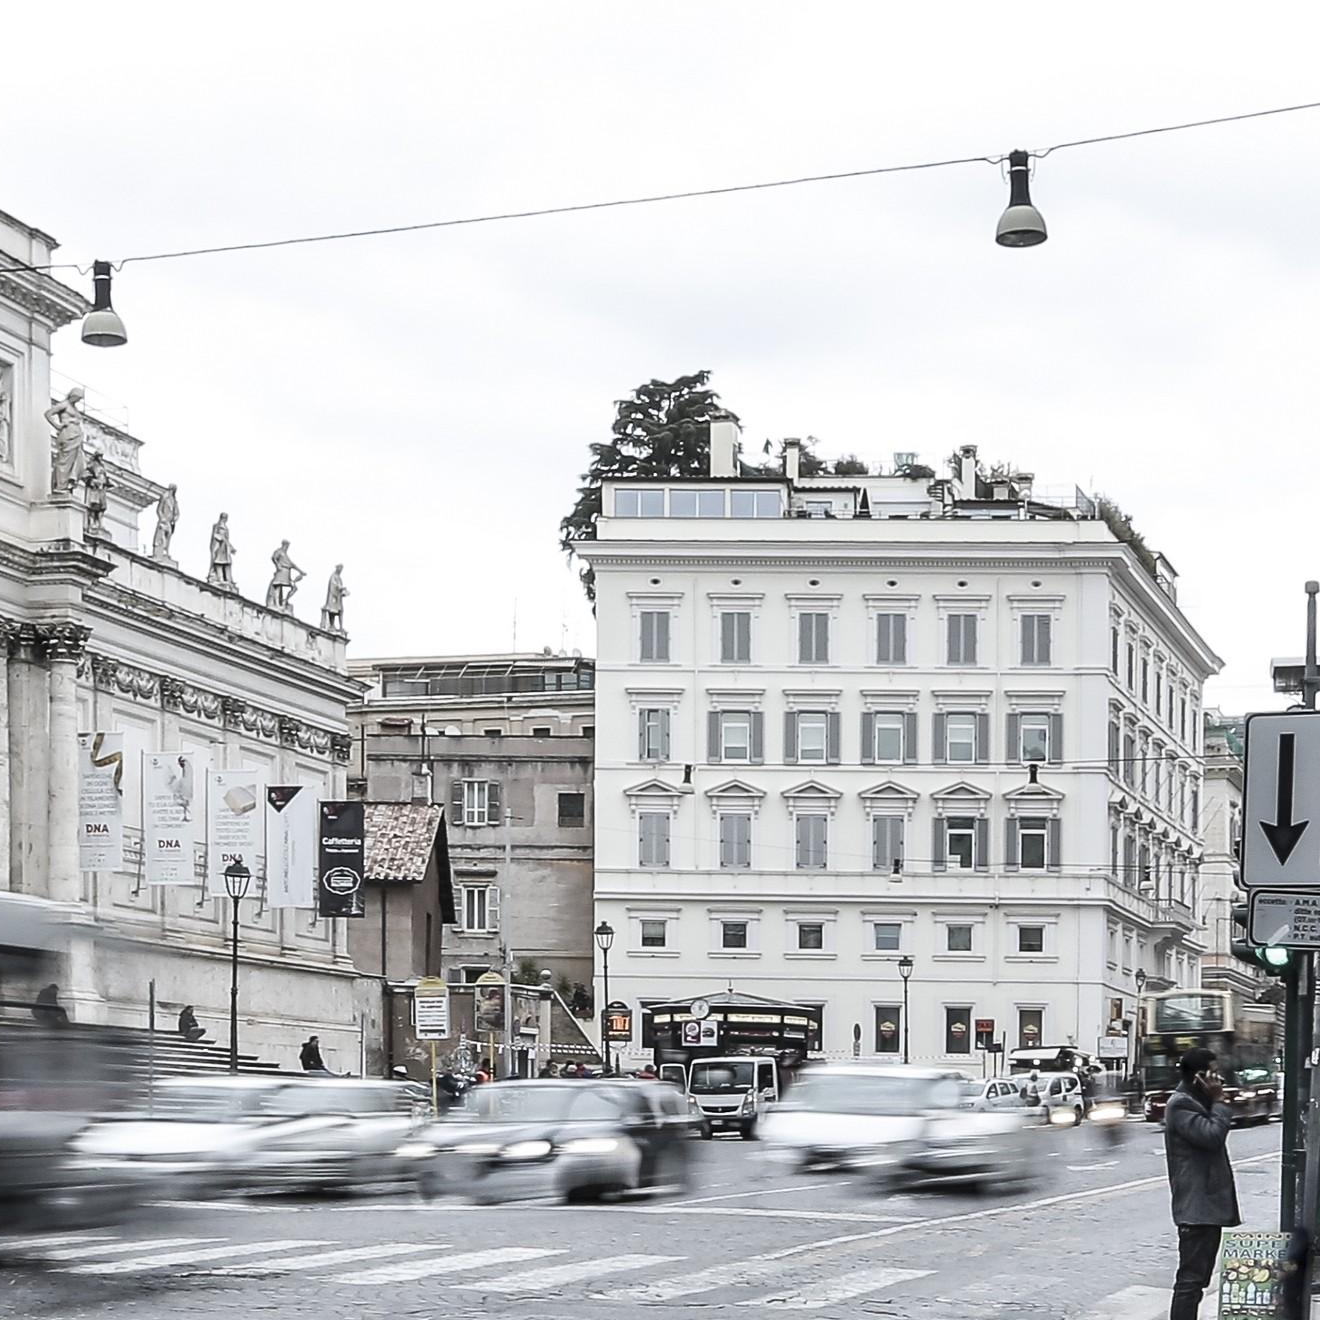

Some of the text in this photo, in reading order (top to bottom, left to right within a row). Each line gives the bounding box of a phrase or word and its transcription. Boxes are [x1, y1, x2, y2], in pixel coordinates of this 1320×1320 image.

[86, 824, 109, 833] DNA
[158, 840, 181, 848] DNA
[322, 837, 362, 845] Caffetteria
[222, 853, 243, 862] DNA
[1223, 1249, 1288, 1258] MARKE
